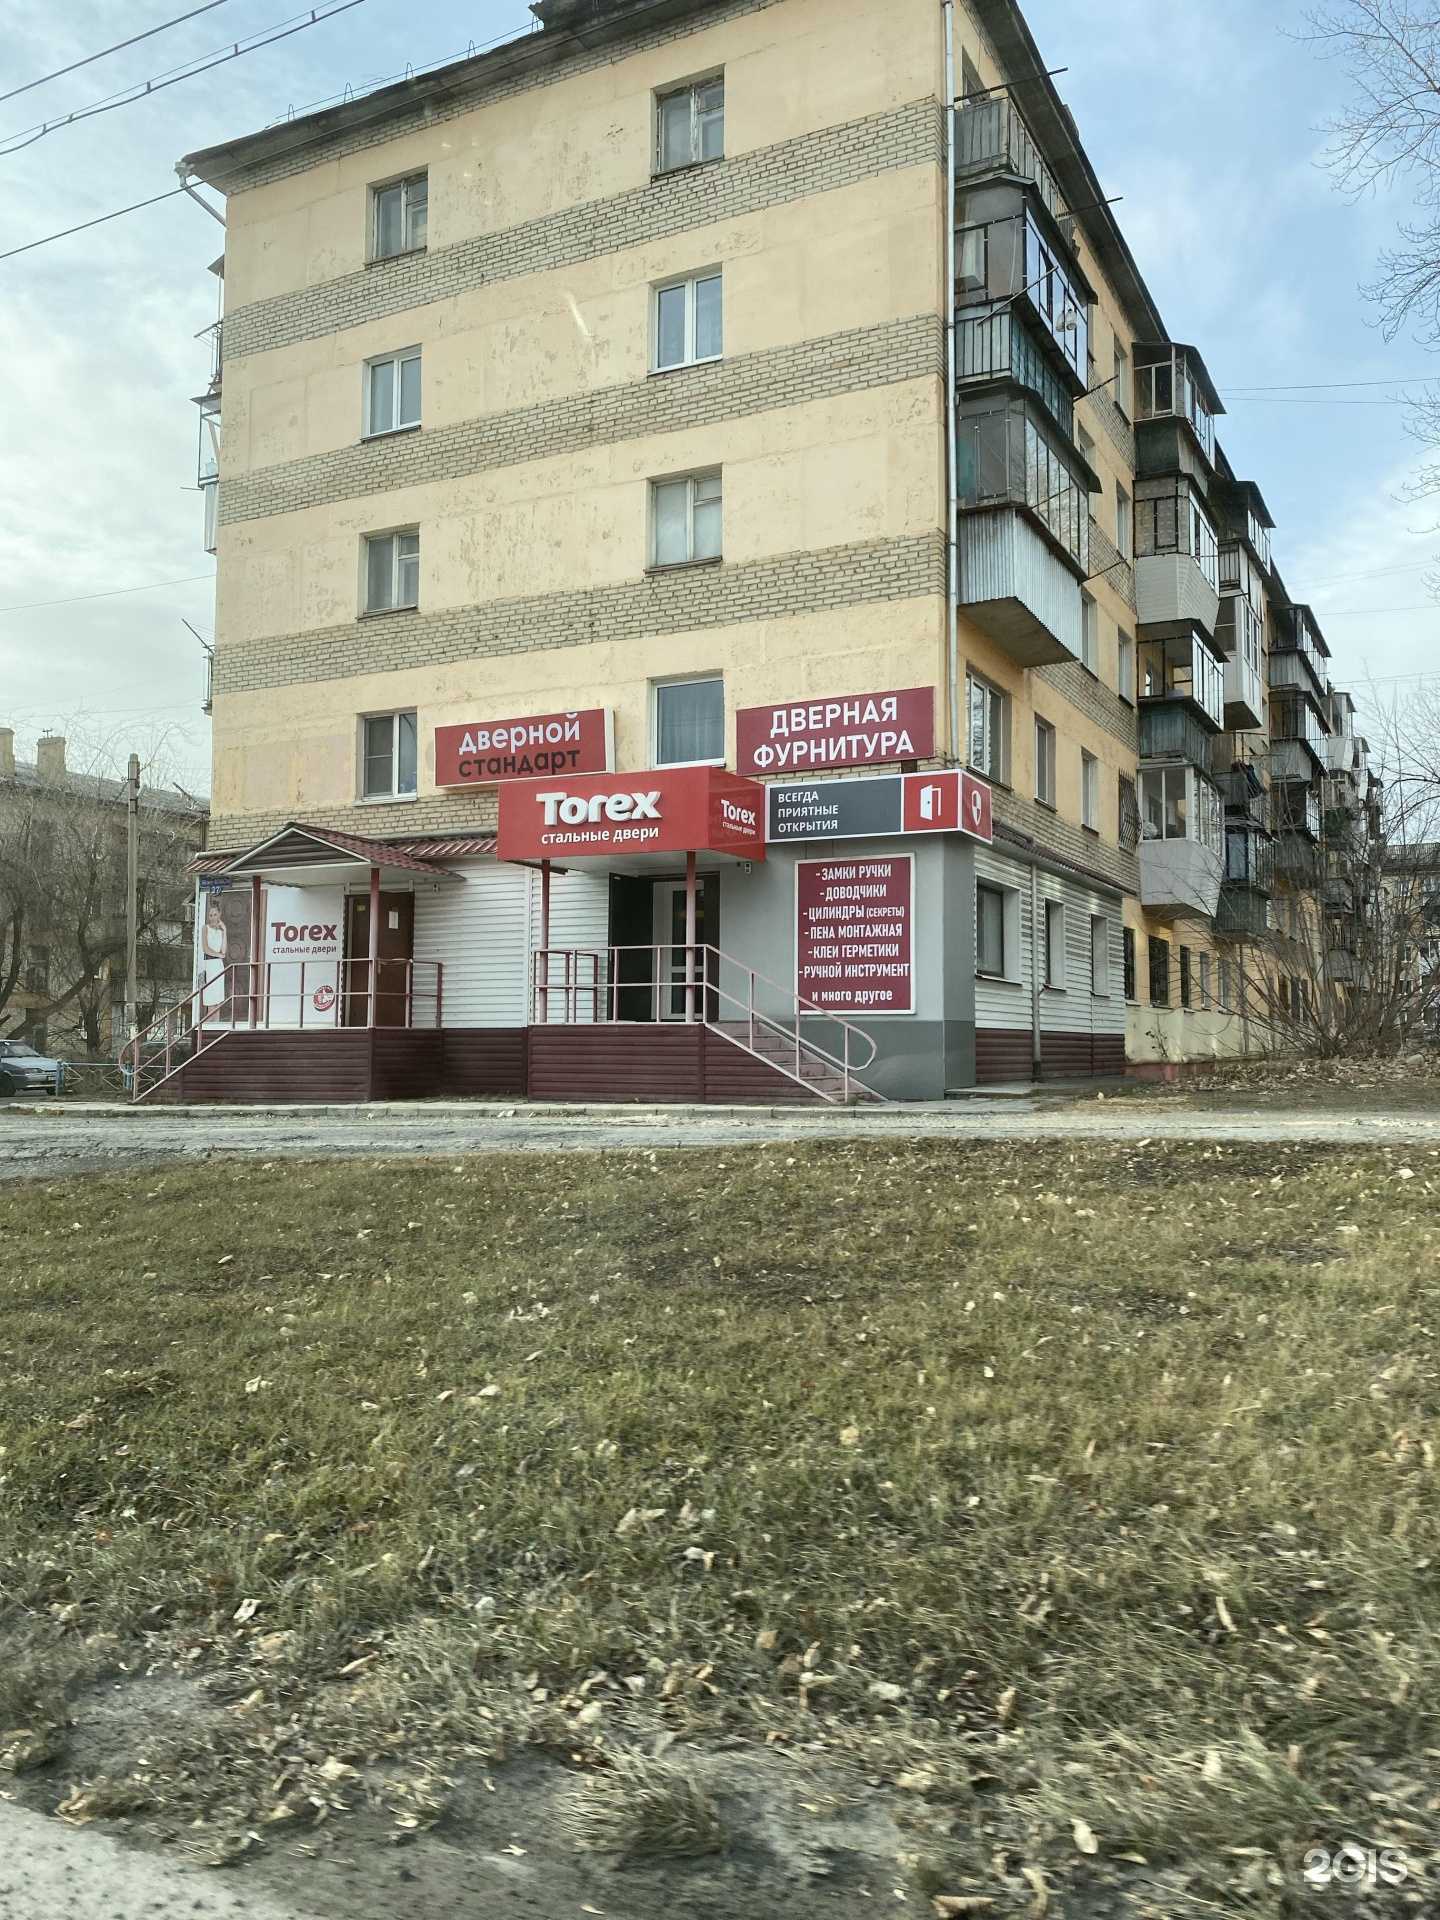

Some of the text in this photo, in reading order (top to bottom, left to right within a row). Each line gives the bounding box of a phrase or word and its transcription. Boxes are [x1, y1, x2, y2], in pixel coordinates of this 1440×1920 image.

[769, 696, 898, 739] ДВЕРНАЯ
[458, 711, 581, 755] дверной
[752, 729, 915, 769] ФУРНИТУРА
[458, 749, 581, 778] стандарт
[777, 790, 820, 803] ВСЕГДА
[535, 789, 663, 827] Torex
[720, 798, 757, 826] Torex
[777, 803, 839, 819] ПРИЯТНЫЕ
[777, 818, 838, 834] ОТКРЫТИЯ
[540, 825, 659, 845] стальные двери
[858, 864, 892, 879] РУЧКИ
[866, 906, 905, 919] (СЕКРЕТЫ)
[271, 921, 338, 943] Torex
[838, 923, 903, 939] МОНТАЖНАЯ
[272, 944, 338, 956] стальные двери
[841, 943, 900, 958] ГЕРМЕТИКИ
[844, 963, 910, 978] ИНСТРУМЕНТ
[812, 989, 893, 1005] и много другое
